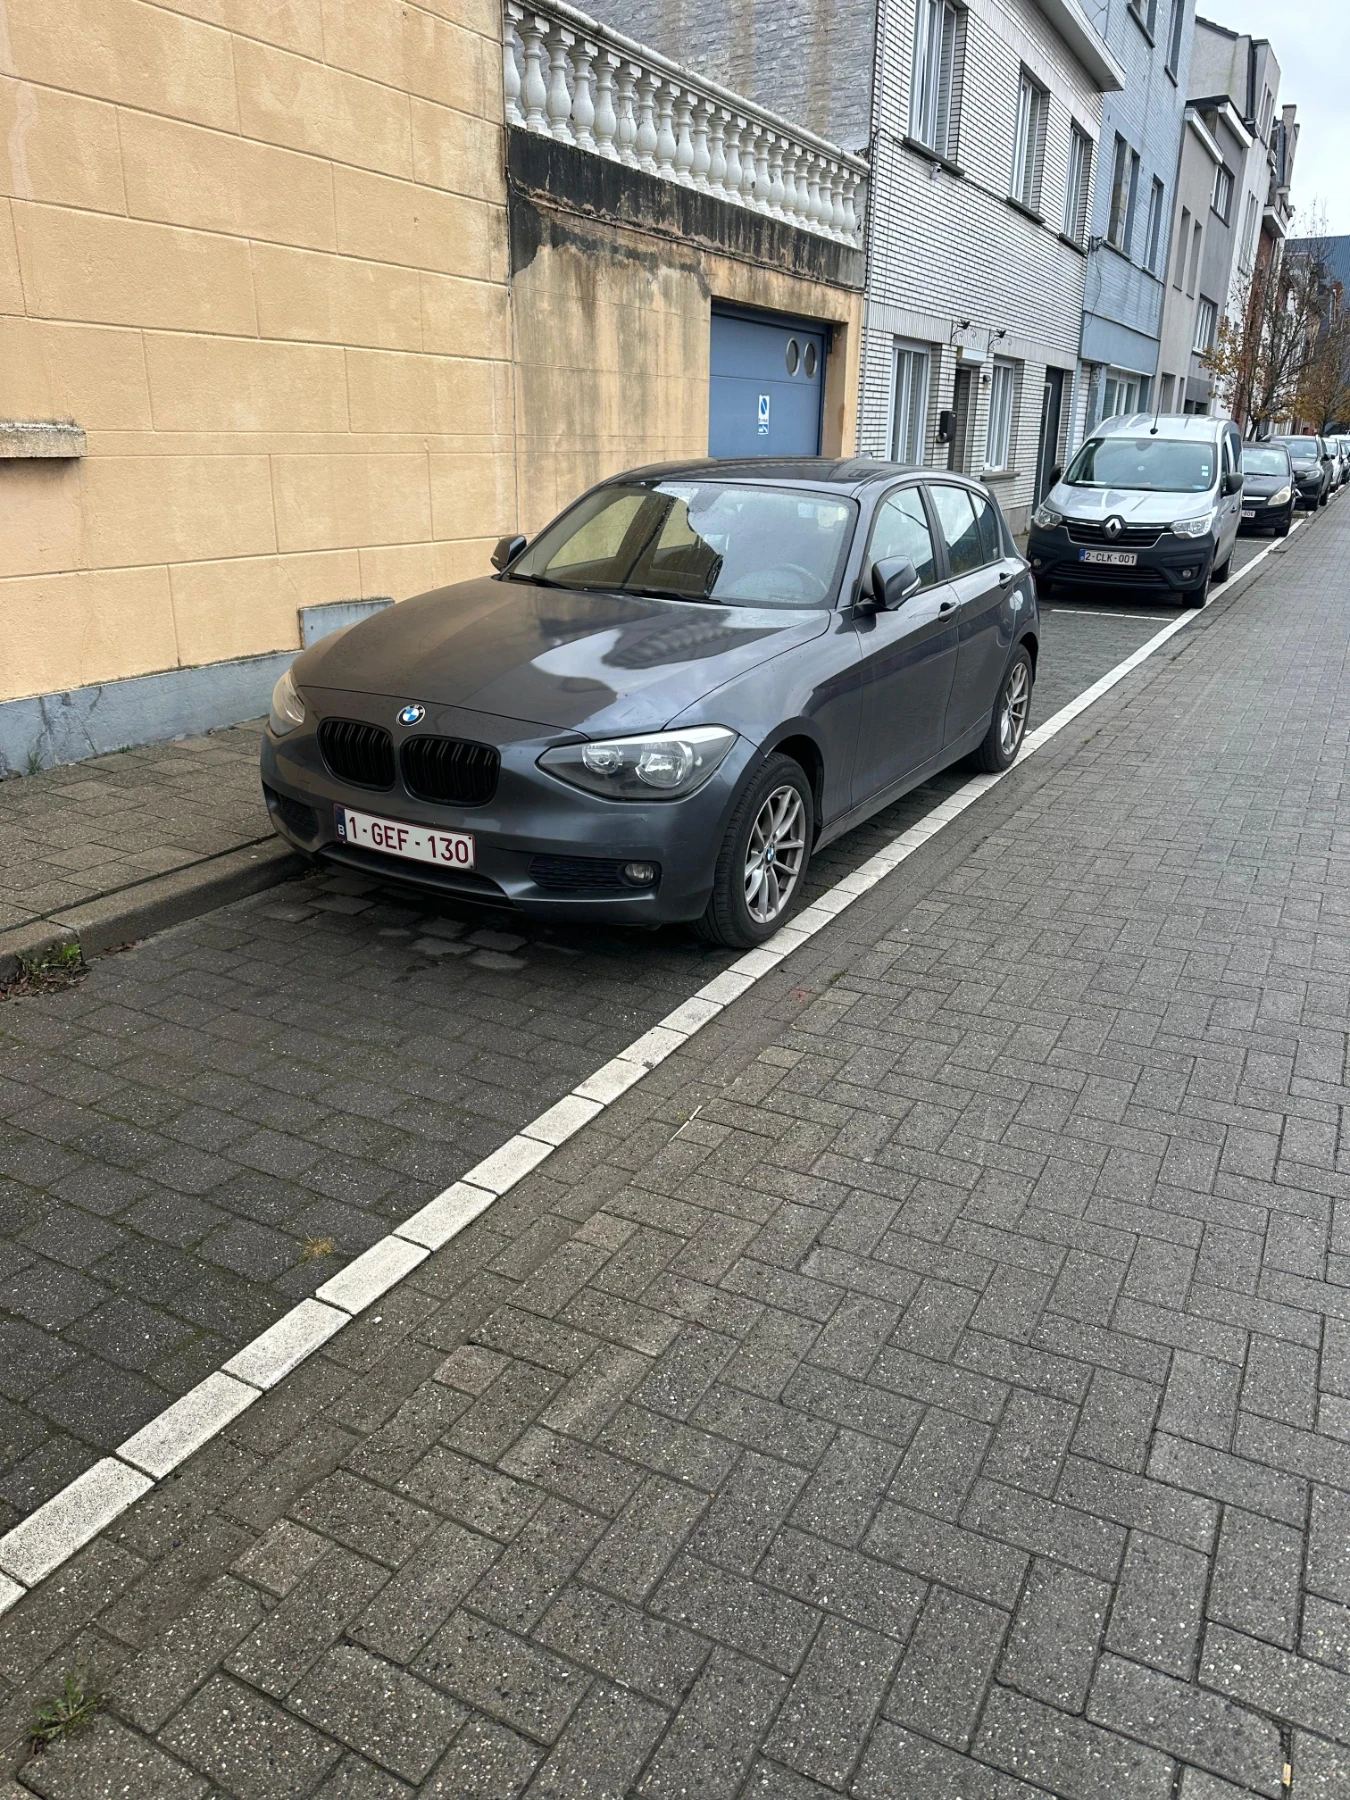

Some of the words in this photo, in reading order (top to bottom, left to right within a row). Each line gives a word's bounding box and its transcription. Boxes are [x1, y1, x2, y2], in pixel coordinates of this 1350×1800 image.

[1085, 552, 1135, 564] 2-CLK-001
[338, 824, 345, 835] B
[349, 816, 469, 864] 1-GEF-130
